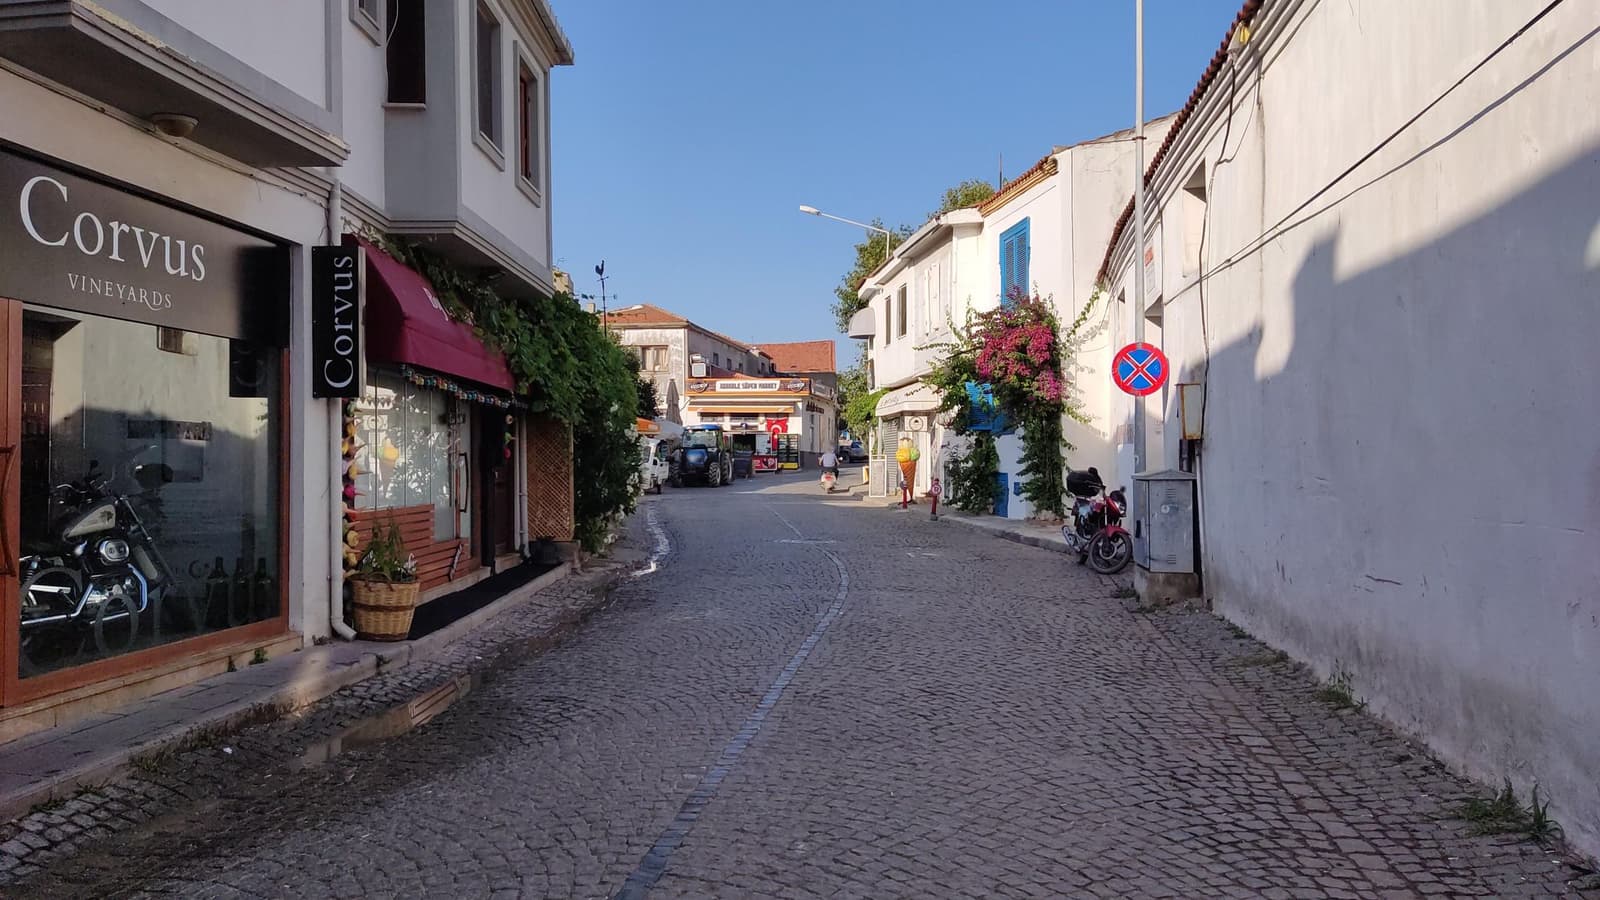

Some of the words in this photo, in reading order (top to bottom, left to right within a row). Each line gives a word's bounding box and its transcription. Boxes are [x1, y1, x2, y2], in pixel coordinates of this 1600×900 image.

[19, 175, 206, 281] Corvus
[68, 273, 173, 311] VINEYARDS
[324, 255, 353, 388] Corvus
